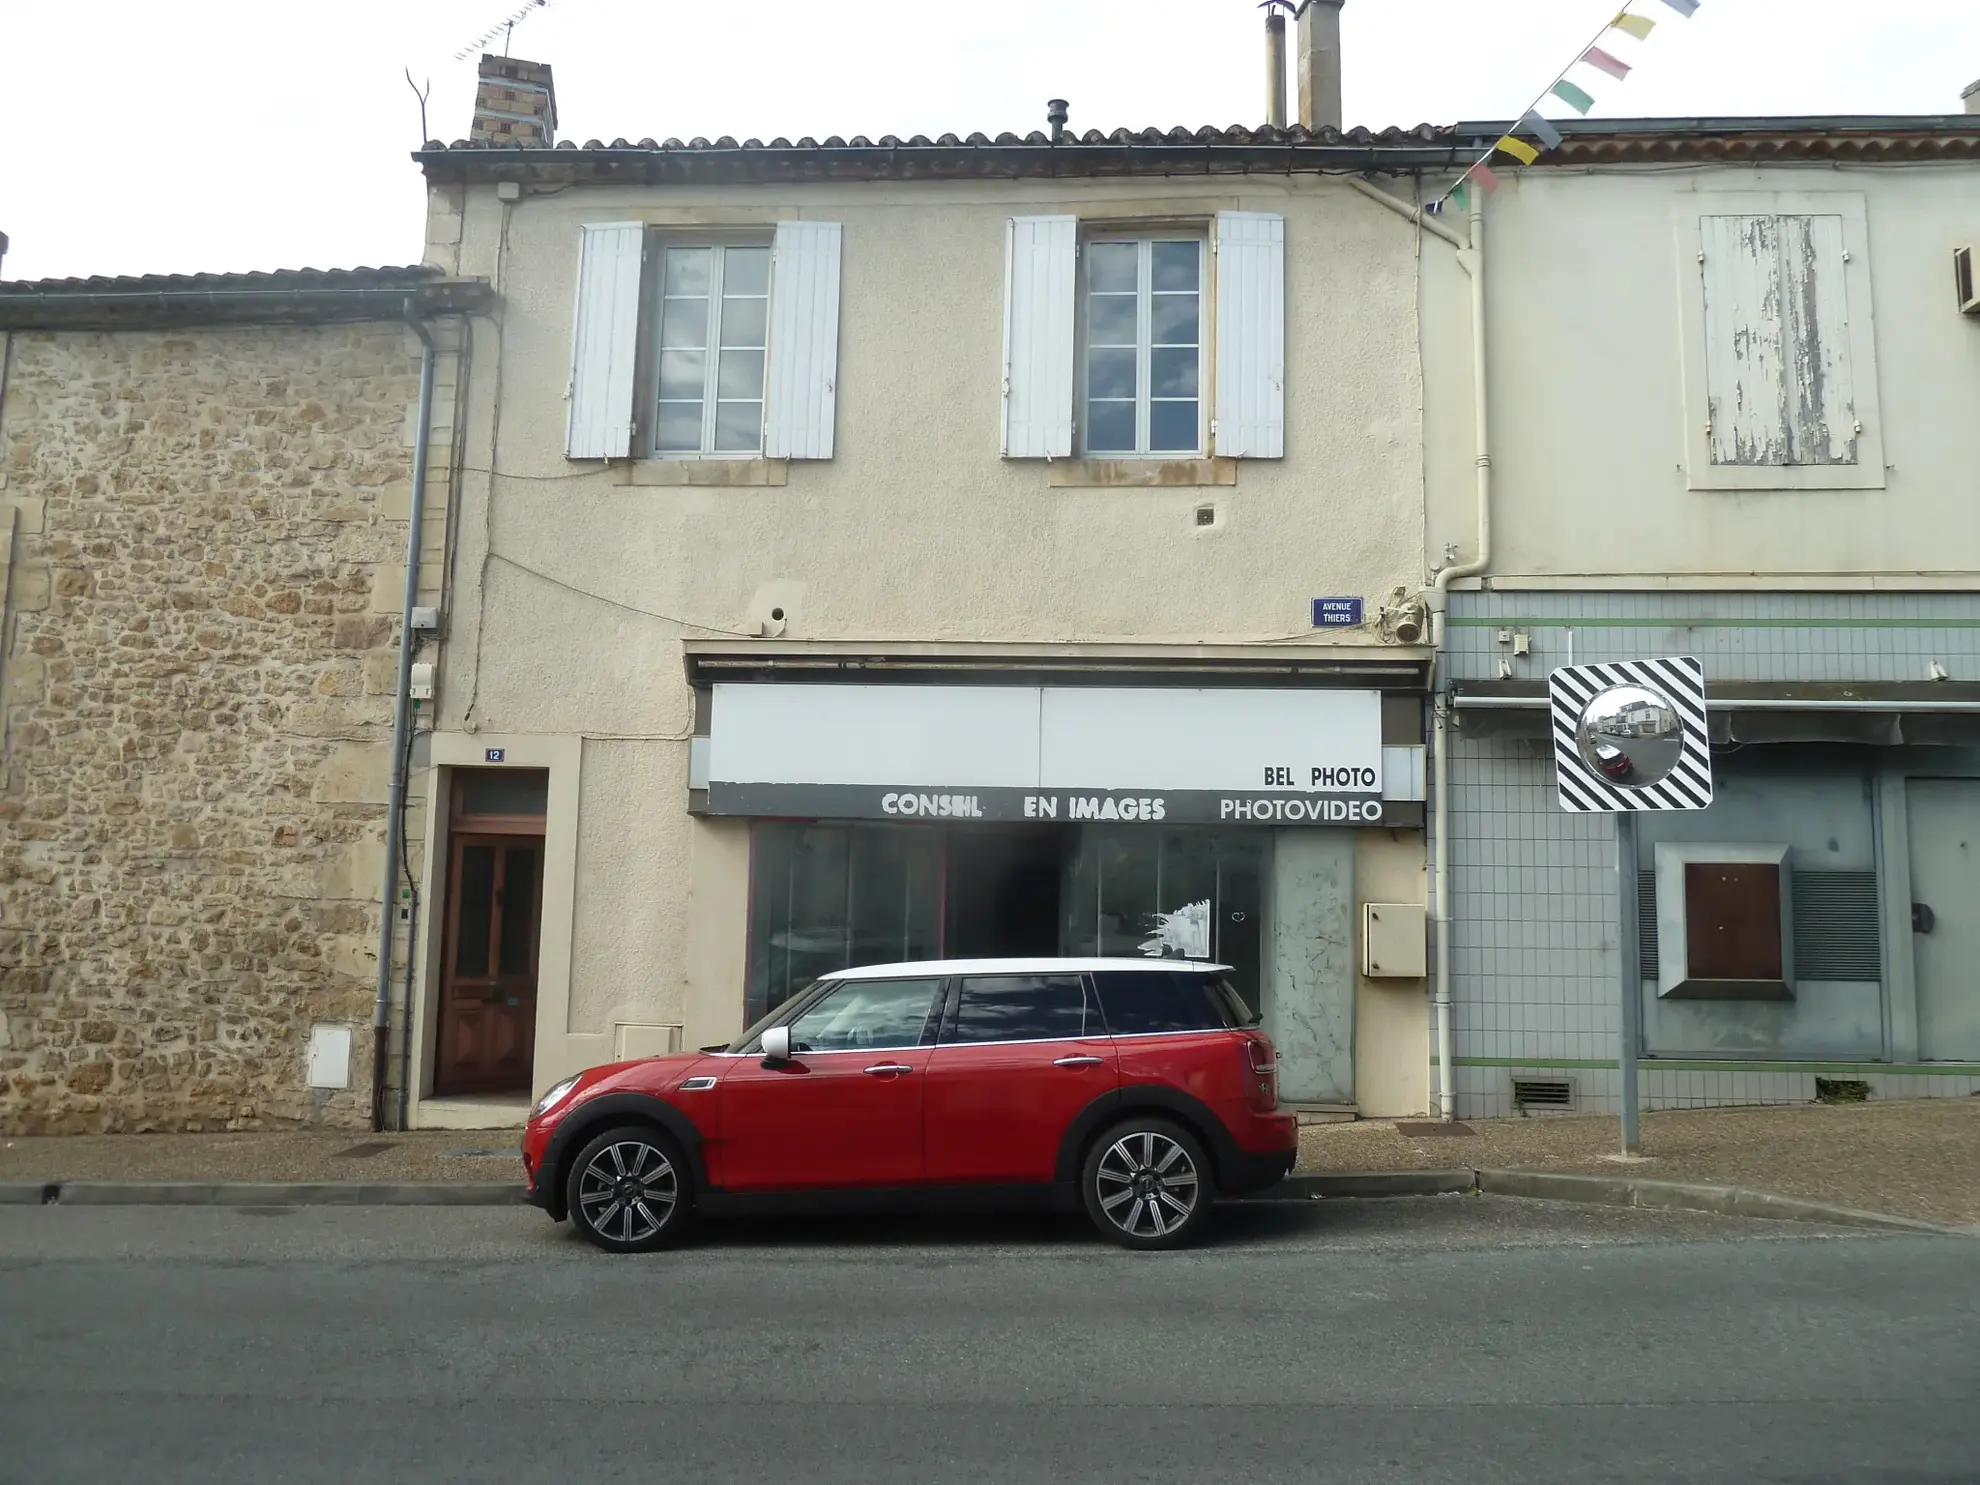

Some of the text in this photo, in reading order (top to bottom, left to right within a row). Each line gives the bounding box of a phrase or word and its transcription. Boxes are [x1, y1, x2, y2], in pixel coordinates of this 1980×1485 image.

[1322, 602, 1352, 611] AVENUE
[1323, 613, 1351, 623] THIERS
[489, 750, 500, 760] 12
[1264, 766, 1377, 787] BEL PHOTO
[1023, 795, 1058, 819] EN
[1068, 796, 1166, 821] IMAGES
[1220, 798, 1383, 821] PHOTOVIDEO
